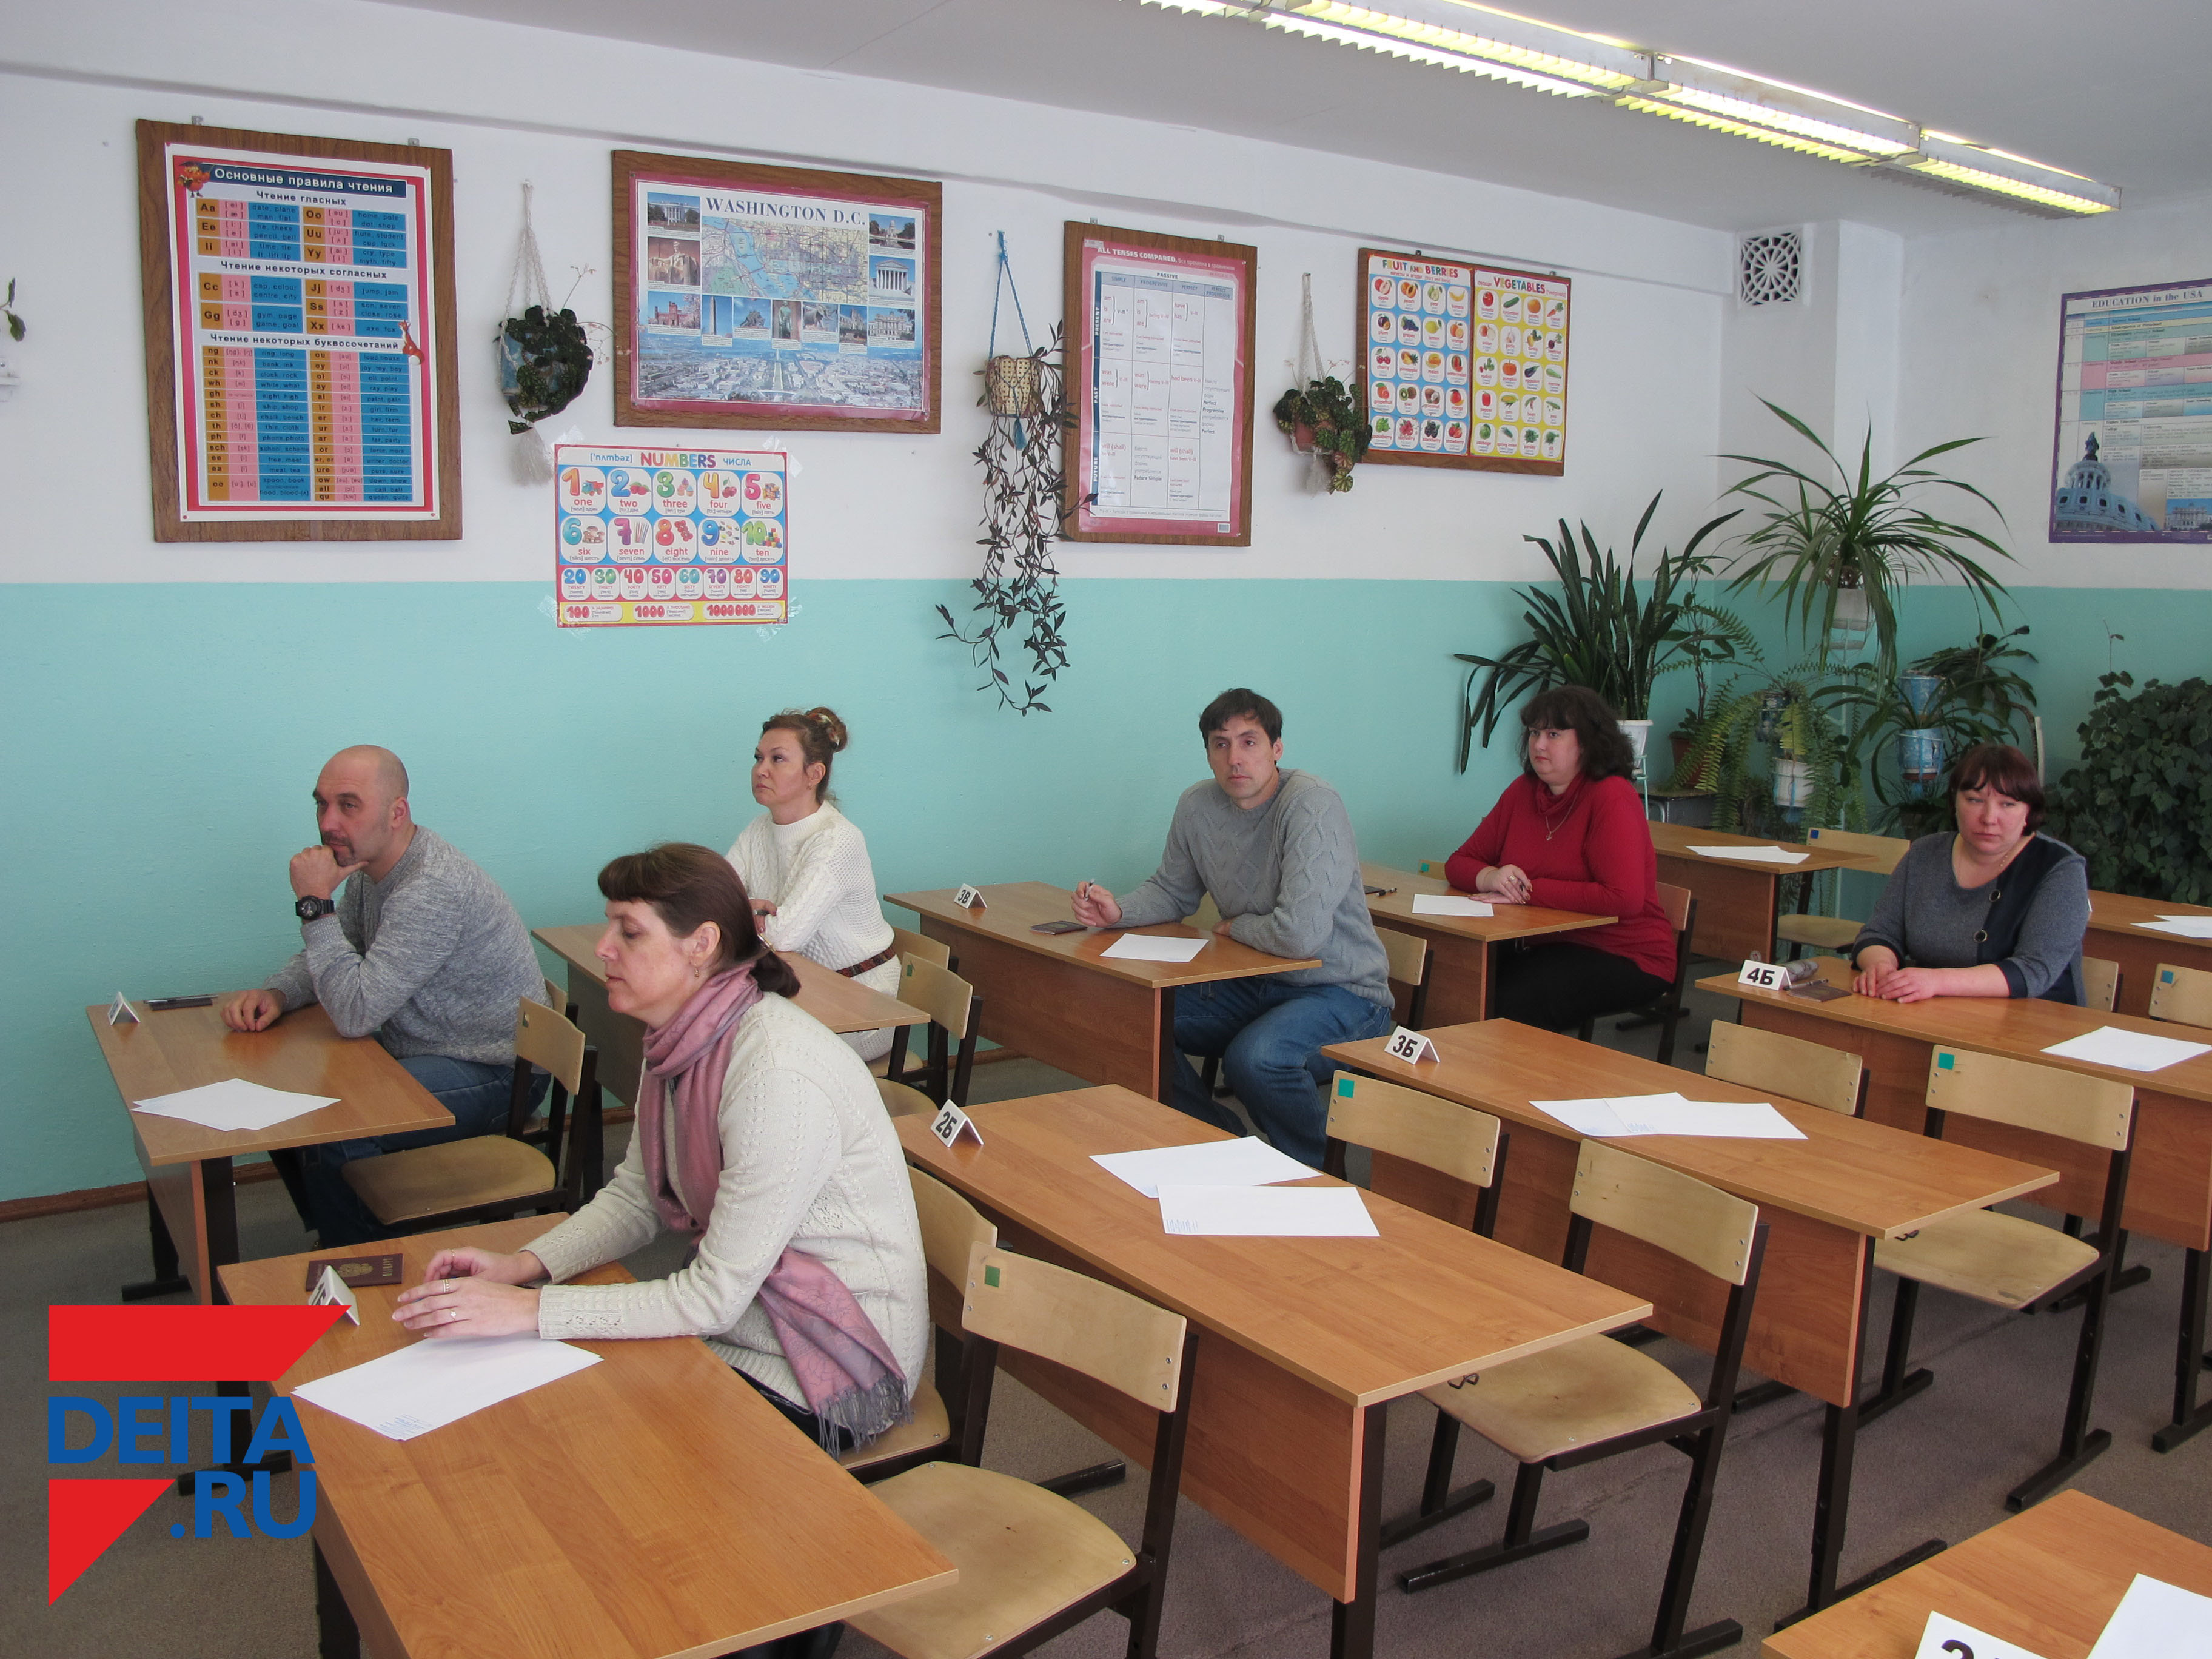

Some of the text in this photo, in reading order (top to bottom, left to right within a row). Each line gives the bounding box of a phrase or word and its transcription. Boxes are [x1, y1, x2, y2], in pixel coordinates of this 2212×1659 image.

[215, 169, 393, 193] Основные правила чтения
[256, 191, 346, 205] Чтение гласных
[306, 210, 321, 219] Oo
[706, 197, 866, 226] WASHINGTON D.C.
[202, 223, 216, 231] Ee
[307, 229, 321, 238] Uu
[308, 249, 321, 259] Yy
[1112, 249, 1138, 258] TENSES
[1139, 252, 1177, 263] COMPARED.
[221, 261, 387, 279] Чтение некоторых согласных
[1382, 260, 1407, 272] FRUIT
[1425, 266, 1458, 278] BERRIES
[204, 283, 218, 291] Cc
[311, 284, 321, 294] Jj
[1494, 277, 1546, 294] VEGETABLES
[2092, 295, 2150, 308] EDUCATION
[2165, 293, 2179, 301] the
[2183, 290, 2203, 299] USA
[204, 311, 220, 321] Gg
[311, 322, 324, 330] Xx
[210, 333, 399, 350] Чтение некоторых буквосочетаний
[640, 452, 716, 468] NUMBERS
[723, 458, 751, 466] ЧИСЛА
[562, 468, 580, 497] 1
[610, 469, 631, 497] 2
[657, 471, 675, 498] 3
[703, 472, 719, 499] 4
[745, 474, 761, 500] 5
[620, 499, 638, 508] two
[663, 499, 688, 508] three
[710, 500, 728, 508] four
[756, 501, 771, 509] five
[562, 518, 582, 545] 6
[614, 518, 632, 545] 7
[655, 519, 675, 546] 8
[701, 520, 719, 546] 9
[741, 521, 767, 545] 10
[665, 547, 688, 557] eight
[564, 569, 586, 584] 20
[595, 569, 617, 584] 30
[624, 569, 644, 584] 40
[651, 569, 672, 584] 50
[679, 569, 700, 584] 60
[707, 569, 726, 584] 70
[734, 569, 753, 584] 80
[760, 569, 780, 583] 90
[566, 606, 590, 618] 100
[634, 605, 665, 618] 1000
[1746, 968, 1775, 985] 4Б
[1393, 1035, 1418, 1057] 3Б
[936, 1111, 957, 1139] 2Б
